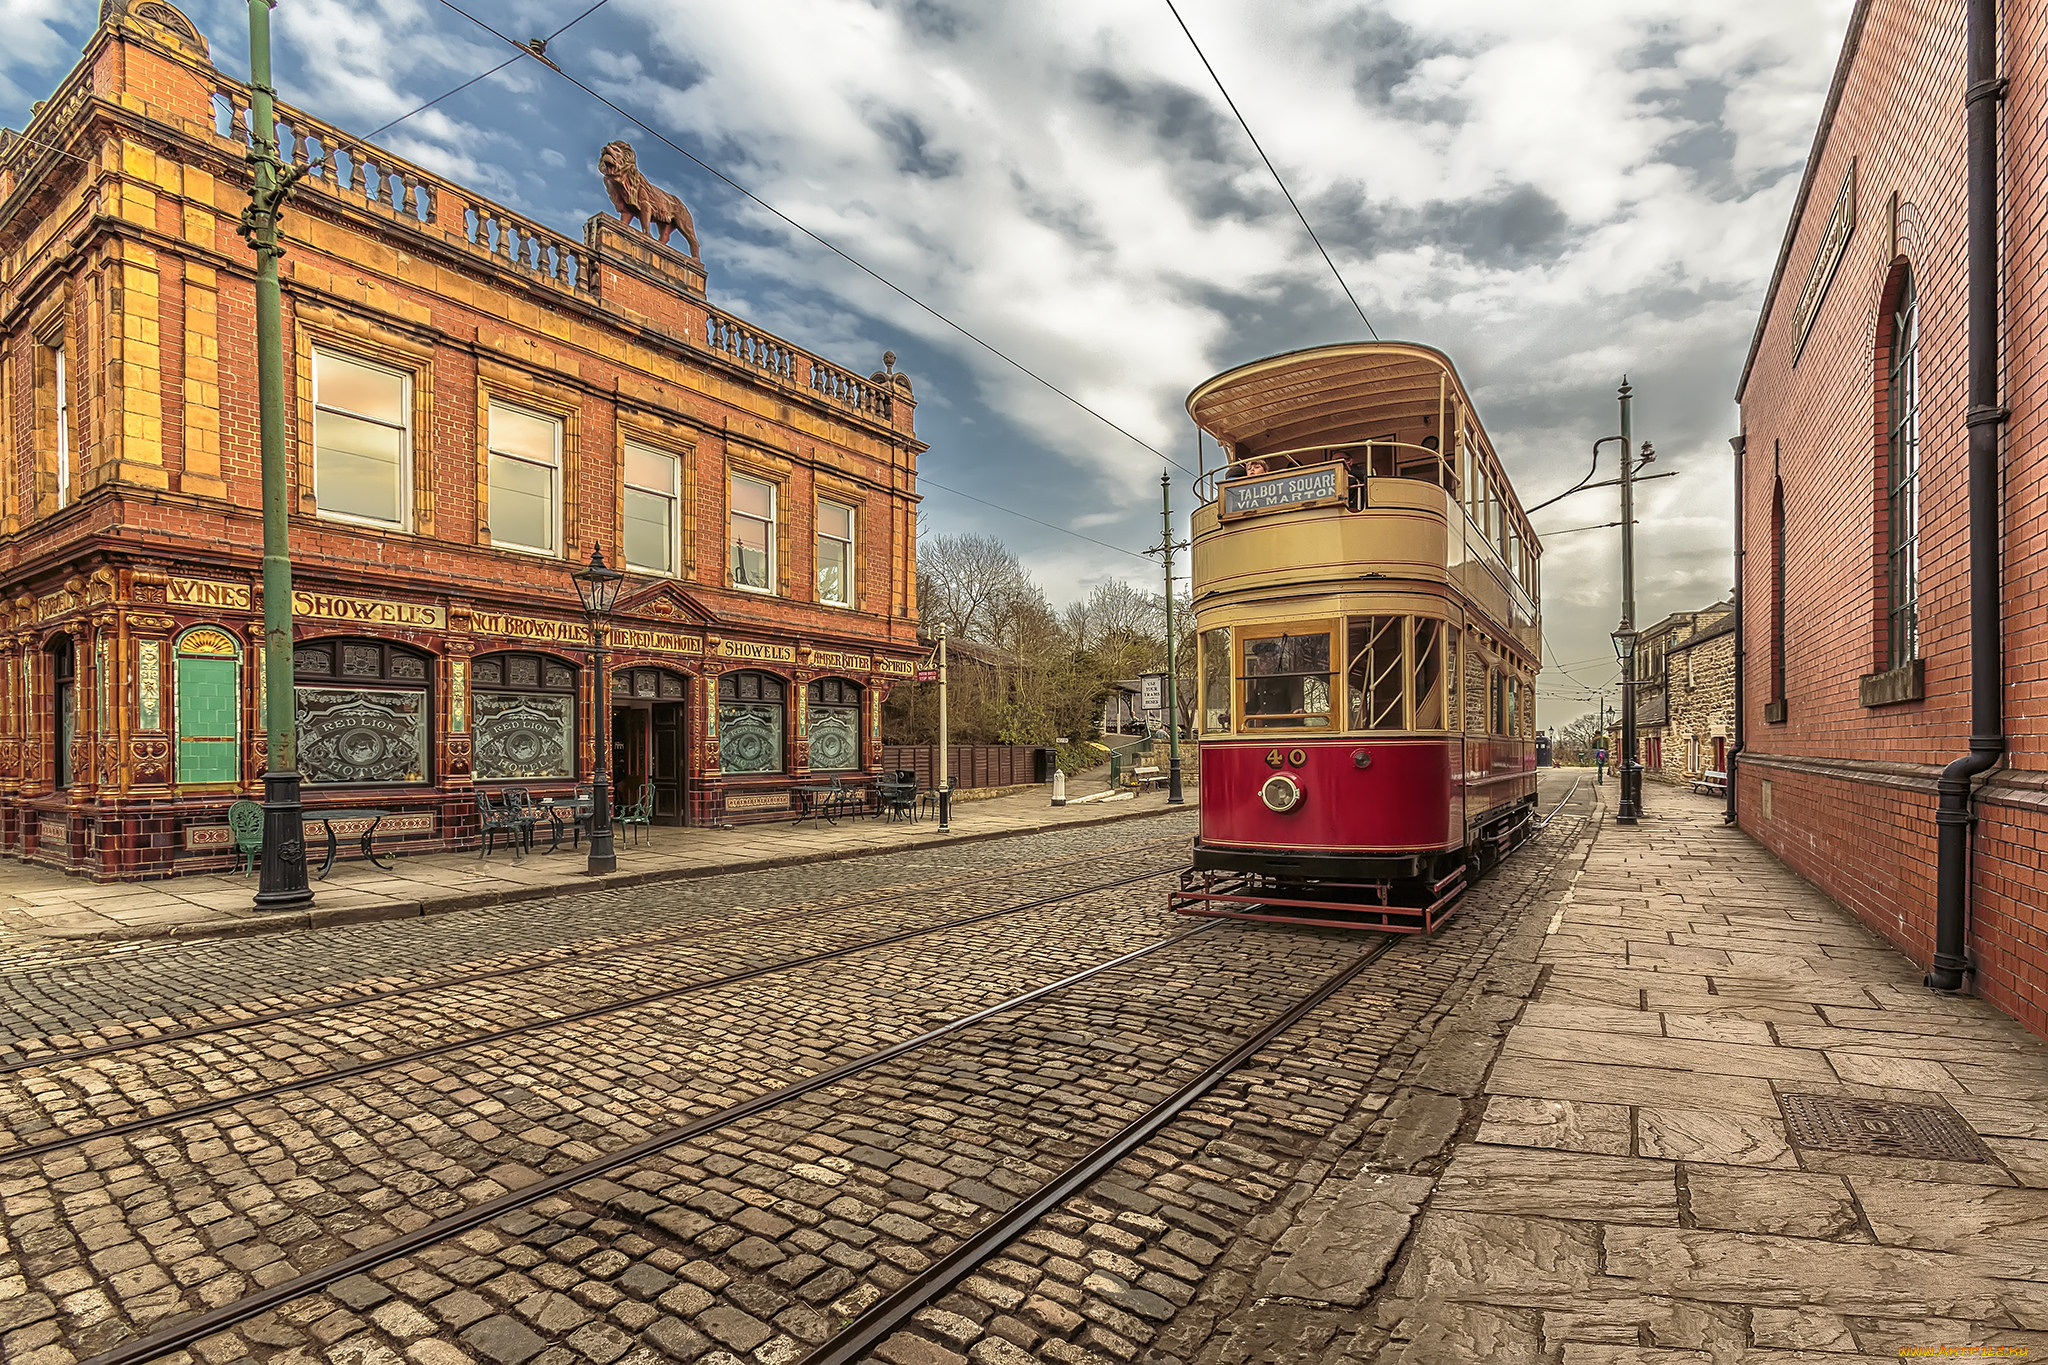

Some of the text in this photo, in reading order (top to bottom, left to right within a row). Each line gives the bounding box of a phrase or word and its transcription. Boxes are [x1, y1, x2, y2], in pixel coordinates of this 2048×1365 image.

[1239, 473, 1336, 501] TALBOT SQUARE
[1237, 487, 1336, 509] VIA MARTON
[168, 578, 250, 607] WINES
[294, 591, 436, 625] SHOWELL'S
[469, 612, 590, 641] NUT BROWN ALES
[608, 630, 701, 652] THE RED LION HOTEL
[841, 652, 870, 671] BITTER
[881, 658, 912, 674] SPIRITS
[322, 719, 397, 732] RED LION
[493, 721, 550, 733] RED LION
[498, 759, 548, 773] HOTEL
[1265, 748, 1307, 767] 40
[328, 760, 395, 777] HOTEL
